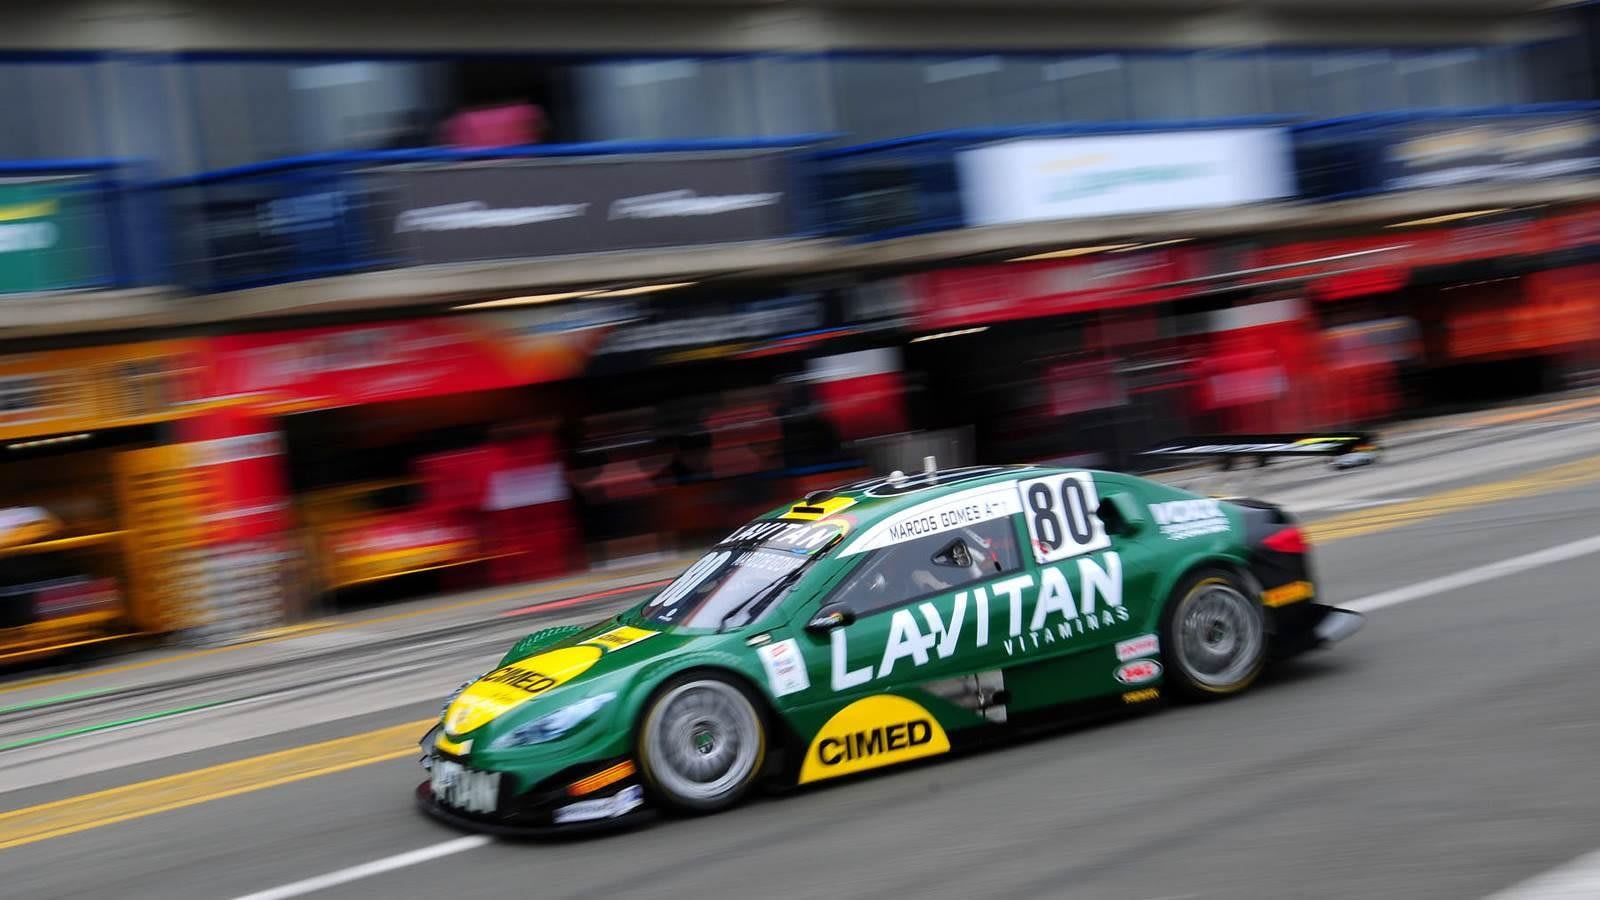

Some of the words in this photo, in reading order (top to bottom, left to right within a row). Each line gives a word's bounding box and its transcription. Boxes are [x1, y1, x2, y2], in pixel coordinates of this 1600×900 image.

[719, 523, 836, 549] LAVITAN
[889, 516, 938, 541] MARCOS
[940, 505, 981, 528] GOMES
[1028, 477, 1093, 550] 80
[831, 551, 1122, 691] LAVITAN
[1003, 606, 1130, 656] VITAMINAS
[482, 667, 556, 693] CIMED
[818, 719, 932, 766] CIMED
